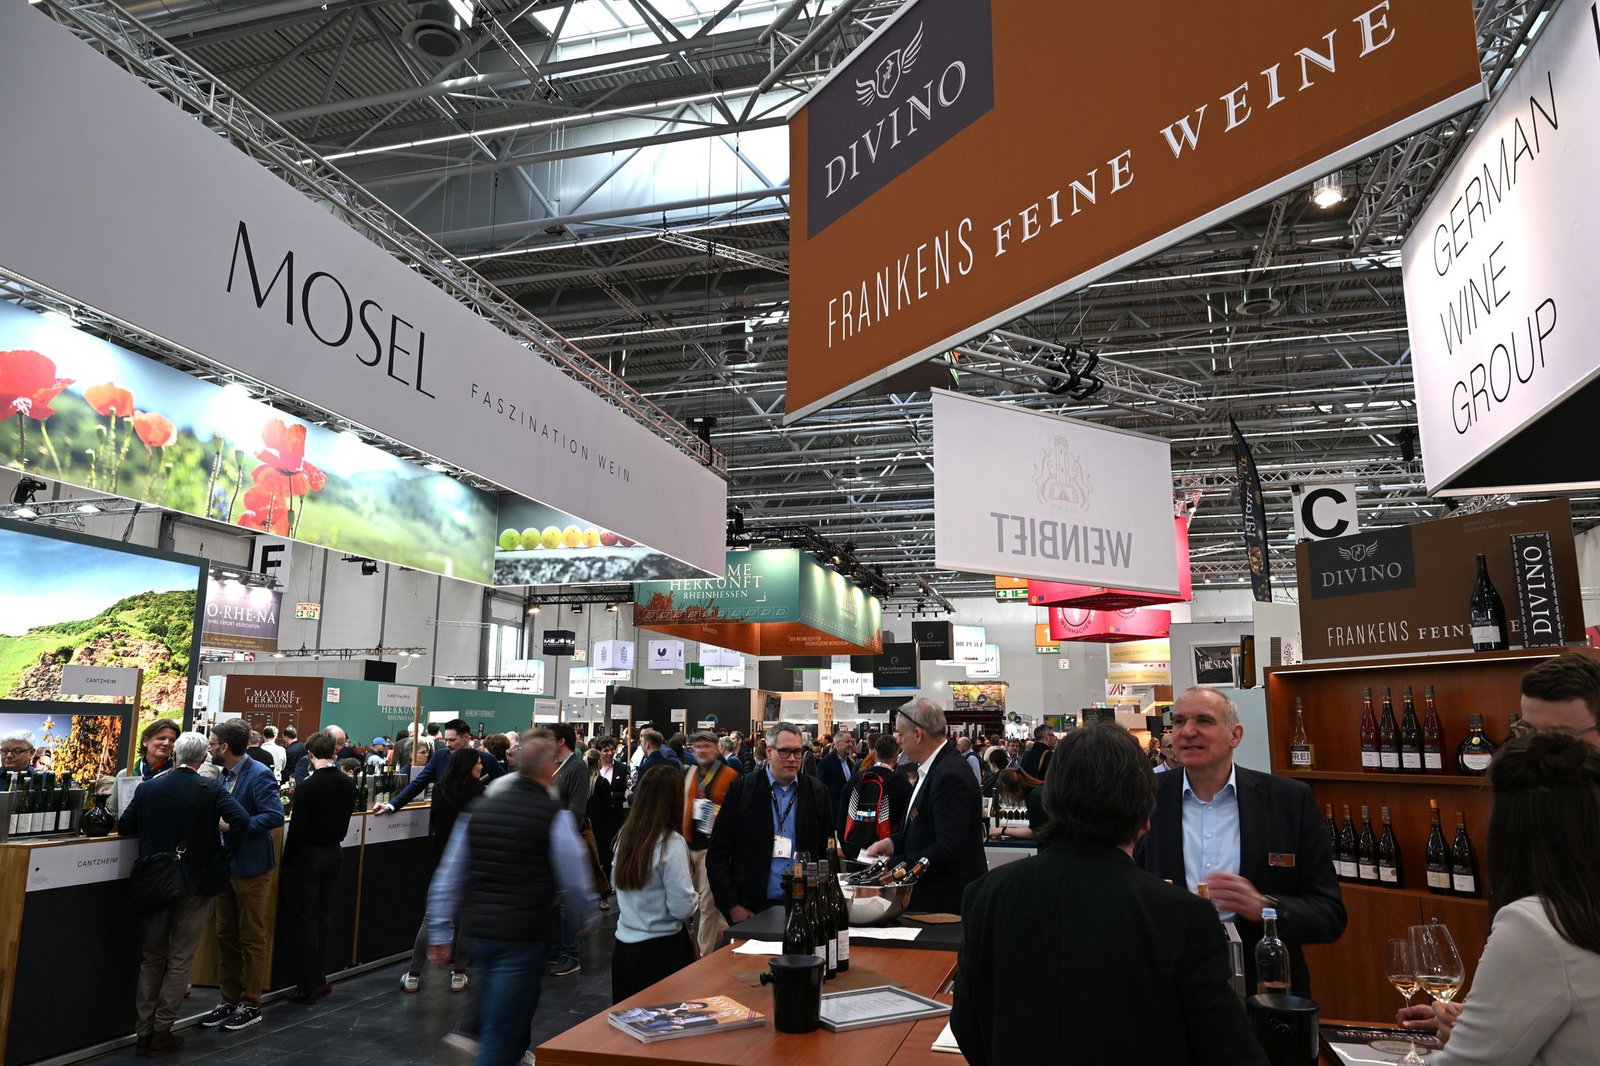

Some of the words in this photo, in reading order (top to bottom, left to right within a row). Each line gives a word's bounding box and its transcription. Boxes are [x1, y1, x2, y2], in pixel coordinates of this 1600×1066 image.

[825, 60, 966, 199] DIVINO
[827, 217, 975, 350] FRANKENS
[992, 149, 1135, 259] FEINE
[1160, 1, 1397, 160] WEINE
[1433, 71, 1559, 277] GERMAN
[227, 220, 436, 400] MOSEL
[1440, 241, 1511, 355] WINE
[1451, 298, 1557, 435] GROUP
[470, 382, 588, 461] FASZINATION
[598, 453, 631, 483] WEIN
[1300, 487, 1350, 539] C
[260, 544, 286, 580] F
[1321, 561, 1402, 588] DIVINO
[670, 575, 763, 591] HERKUNFT
[683, 590, 748, 600] RHEINHESSEN
[1523, 545, 1552, 636] DIVINO
[1327, 619, 1410, 648] FRANKENS
[1417, 622, 1473, 640] FEIN
[85, 677, 117, 685] CANTZHEIM
[253, 689, 296, 698] MAXIME
[246, 695, 302, 705] HERKUNFT
[381, 704, 425, 715] HERKUNT
[77, 856, 119, 868] CANTZHEIM
